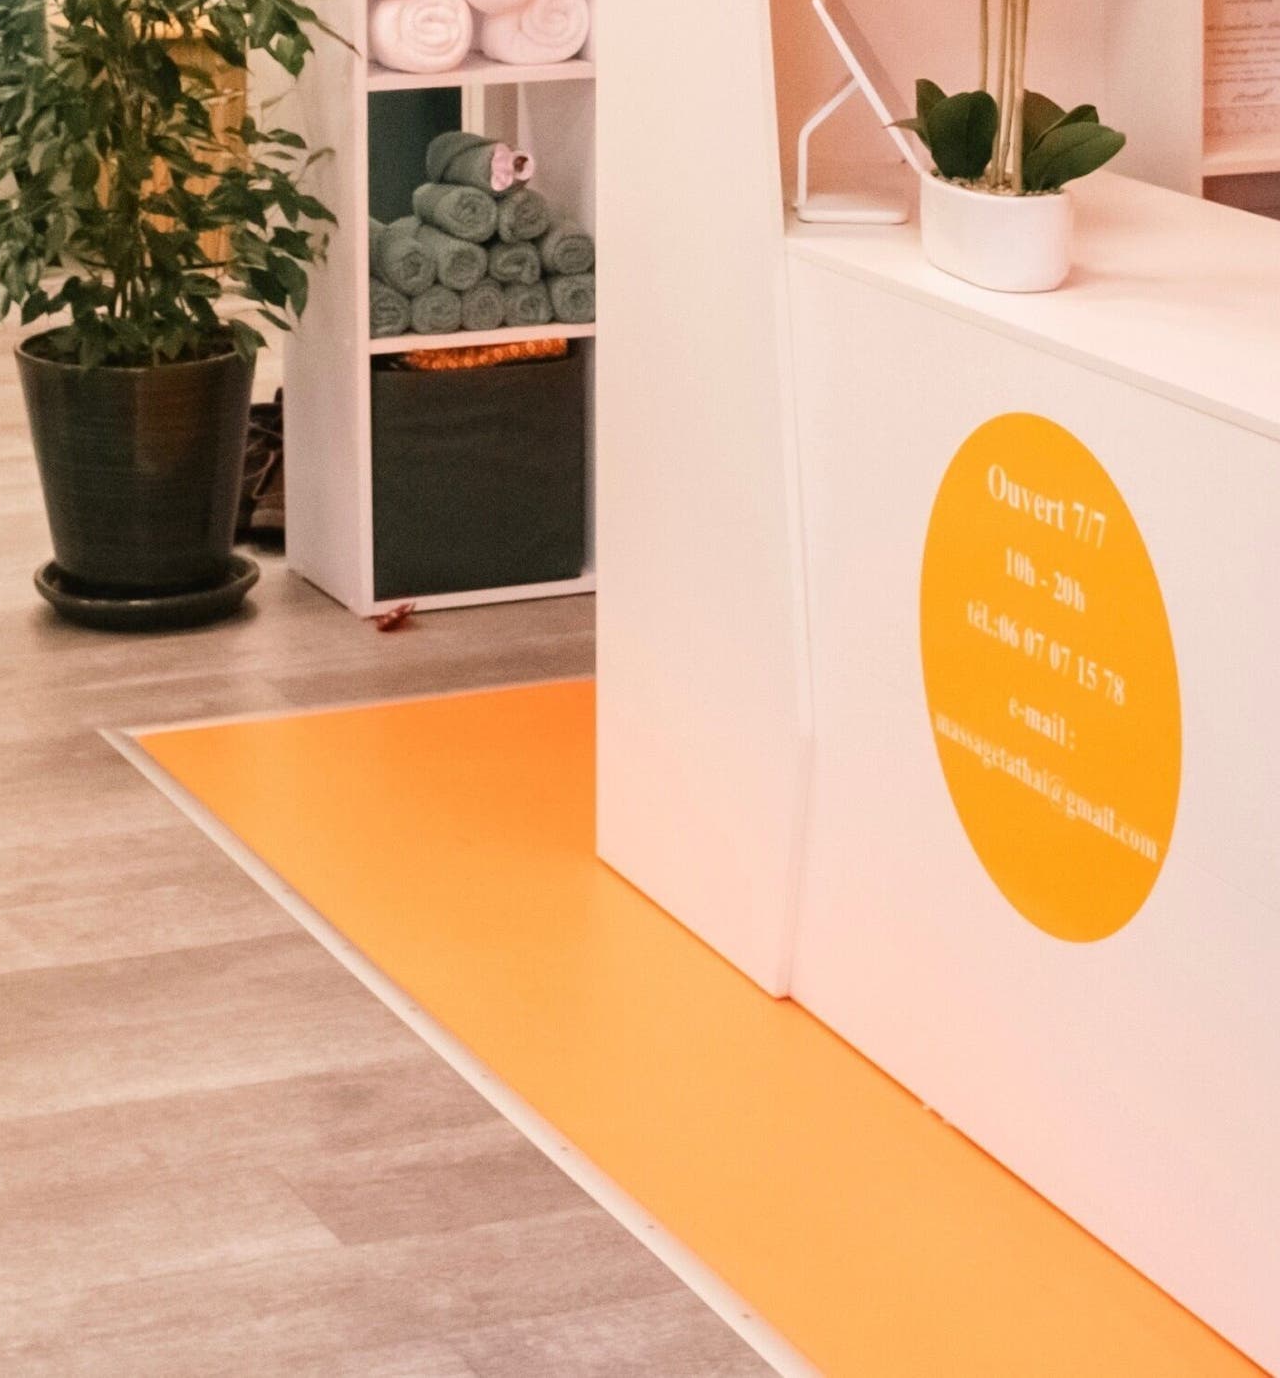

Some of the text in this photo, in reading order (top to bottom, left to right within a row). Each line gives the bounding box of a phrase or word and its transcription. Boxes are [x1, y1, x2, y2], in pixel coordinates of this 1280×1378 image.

[987, 464, 1107, 550] Ouvert 7/7
[1006, 547, 1035, 588] 10h
[1053, 571, 1086, 613] 20h
[1024, 627, 1045, 662] 07
[1049, 641, 1071, 677] 07
[1078, 656, 1098, 691] 15
[1103, 669, 1125, 706] 78
